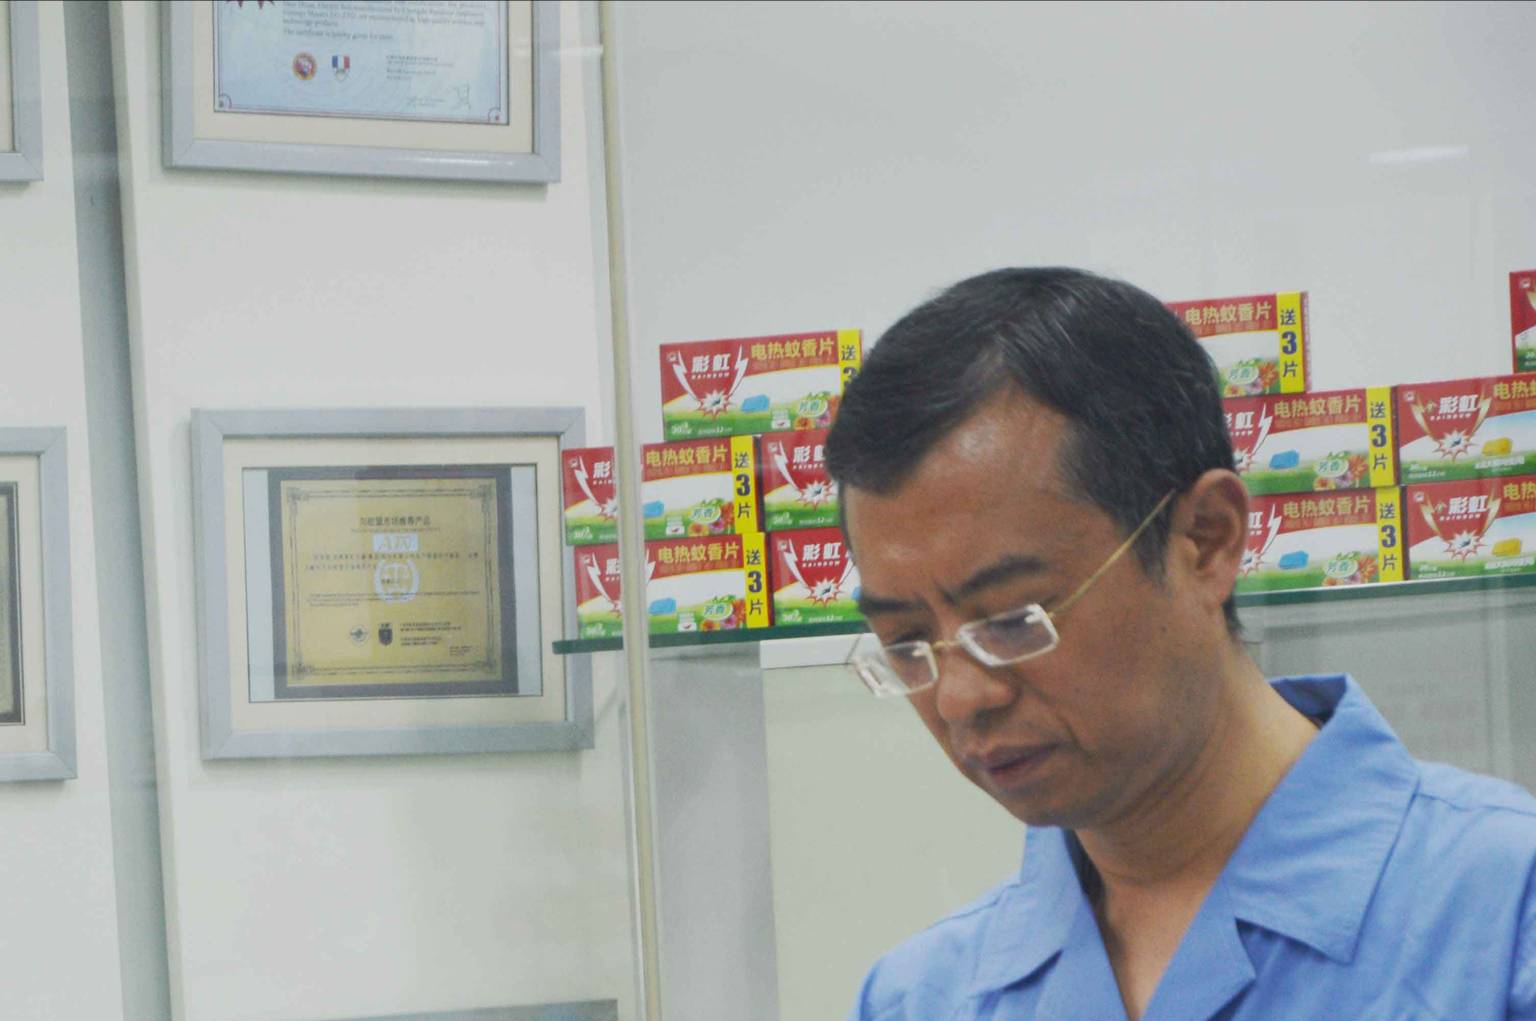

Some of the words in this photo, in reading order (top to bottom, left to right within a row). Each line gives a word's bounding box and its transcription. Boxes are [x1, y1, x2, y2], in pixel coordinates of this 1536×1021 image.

[1185, 301, 1272, 325] 电热蚊香片
[751, 337, 834, 360] 电热蚊香片
[691, 353, 731, 374] 彩虹
[1274, 395, 1362, 419] 电热蚊香片
[646, 444, 728, 467] 电热蚊香片
[1283, 496, 1370, 519] 电热蚊香片
[658, 542, 740, 564] 电热蚊香片
[802, 542, 842, 561] 彩虹
